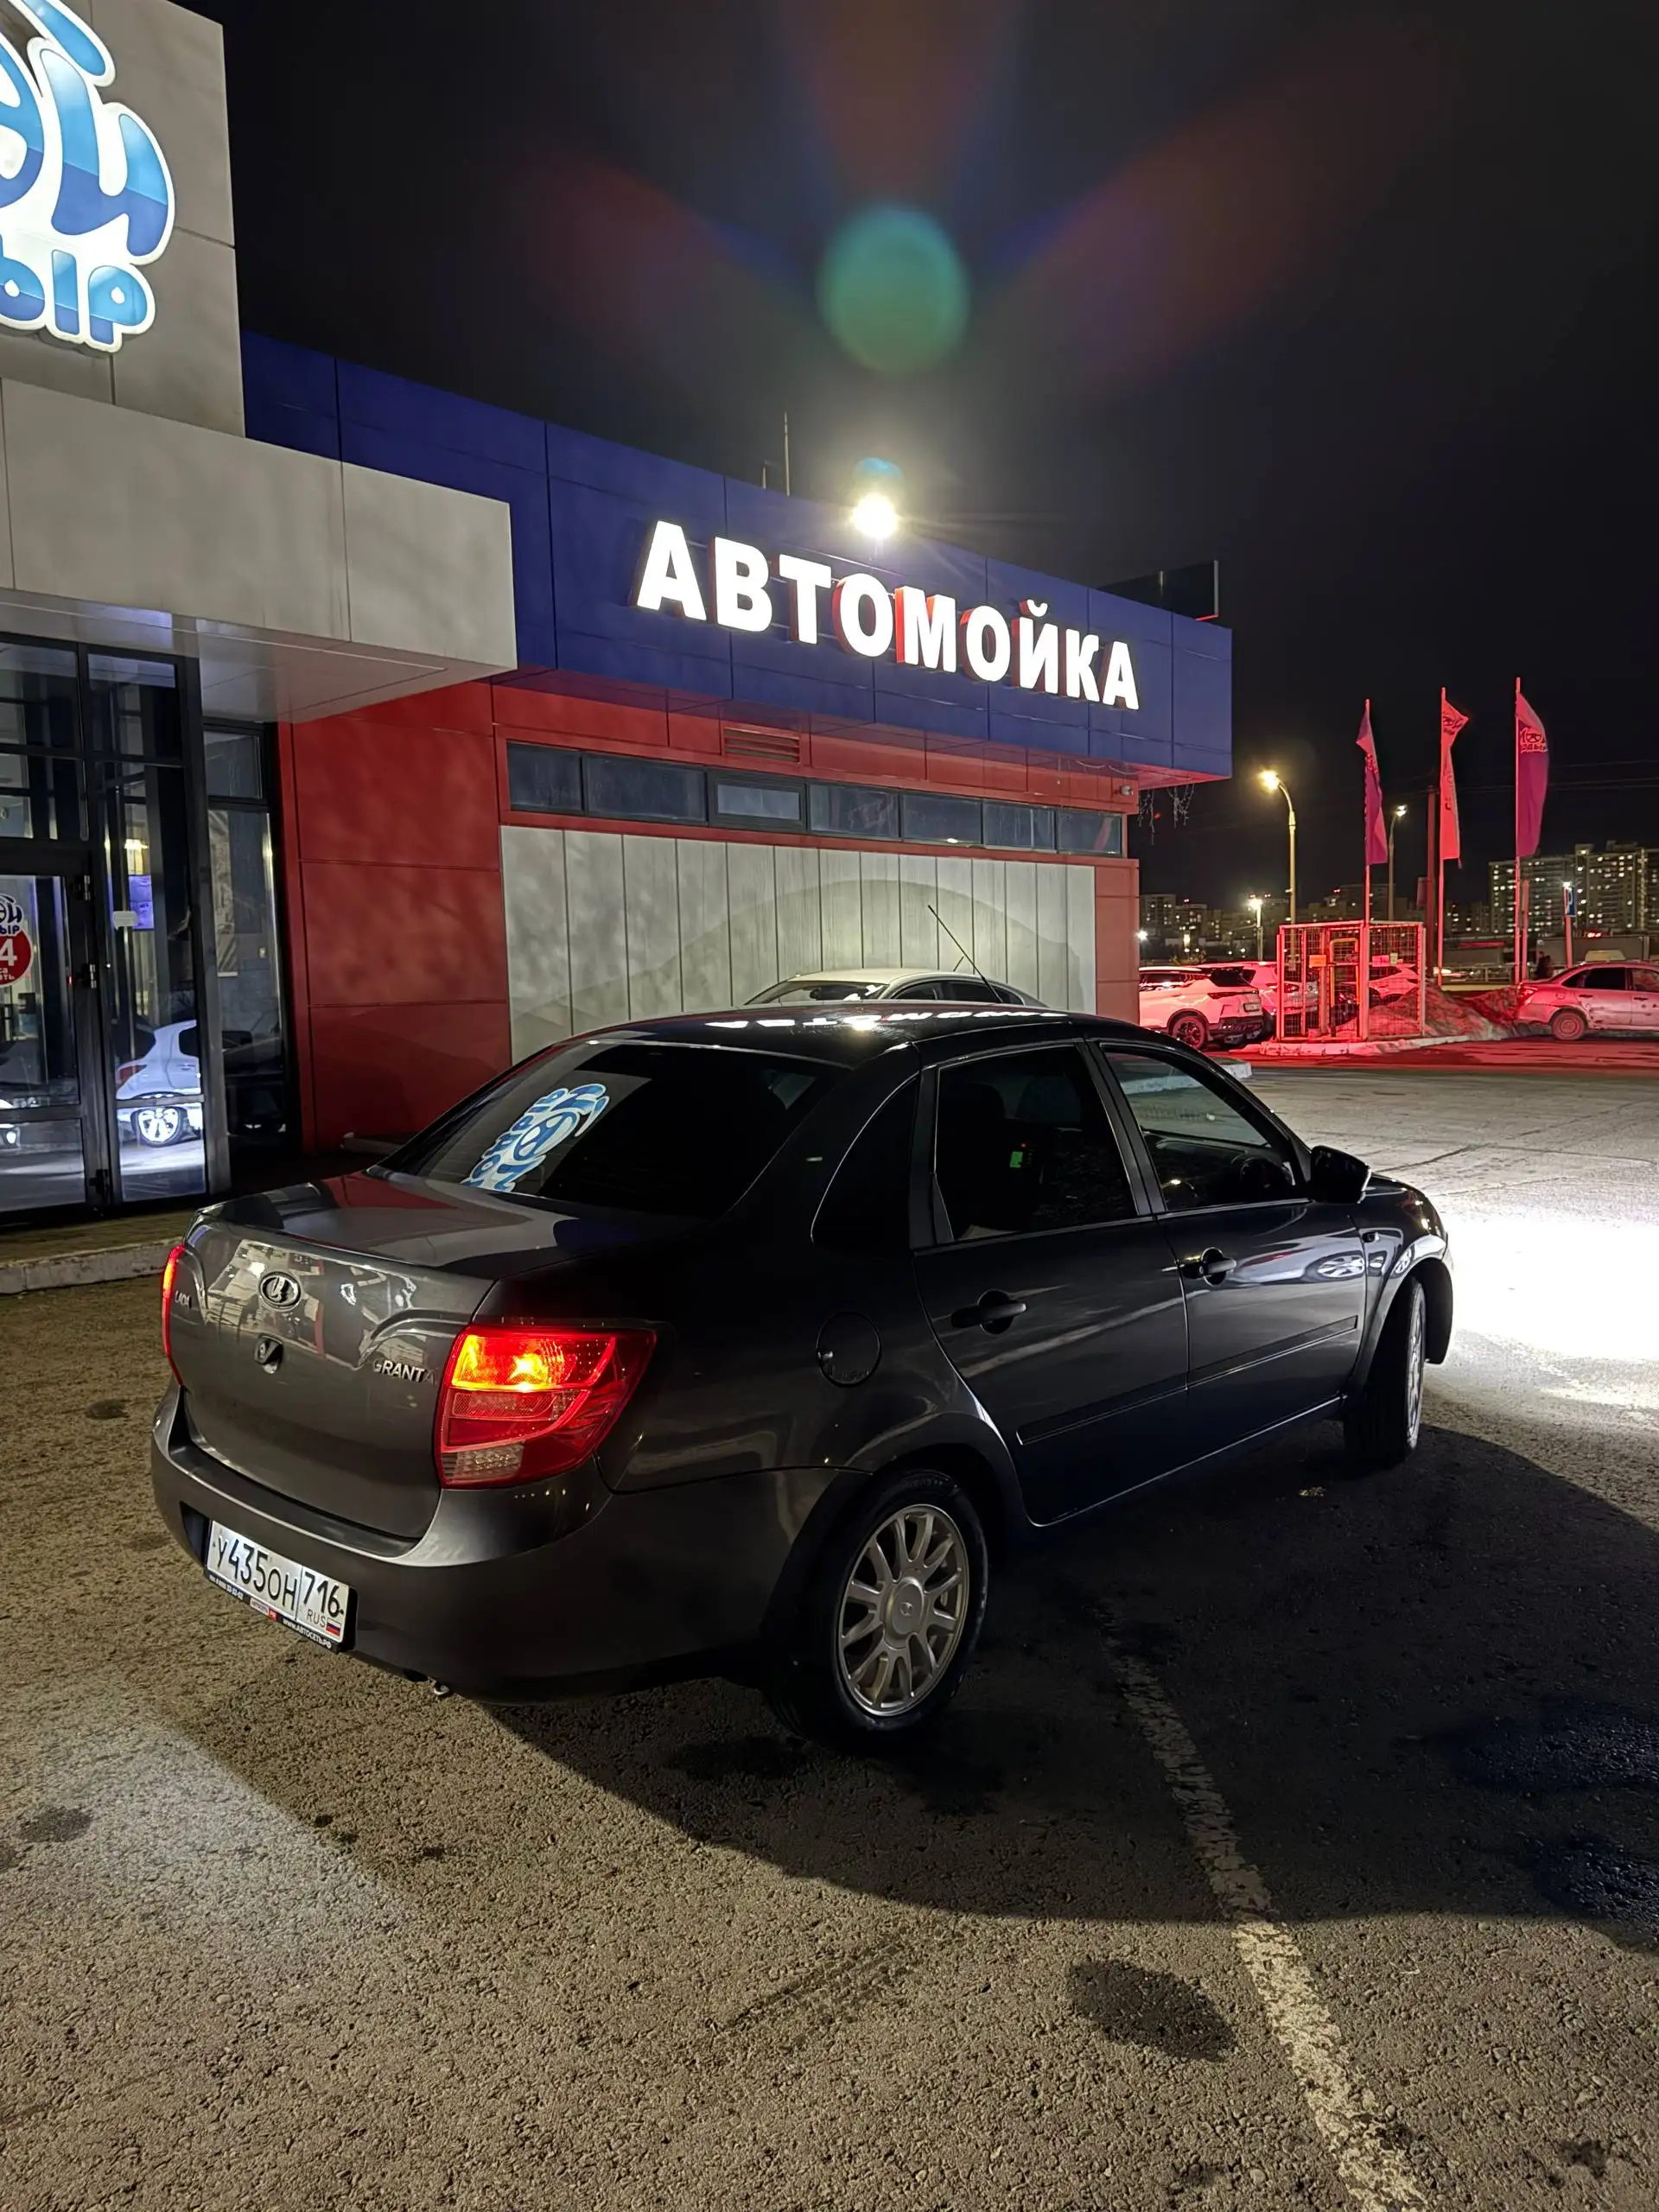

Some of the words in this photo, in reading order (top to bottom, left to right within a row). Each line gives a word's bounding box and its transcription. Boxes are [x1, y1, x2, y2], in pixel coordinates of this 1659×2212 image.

[636, 520, 1140, 710] АВТОМОЙКА
[372, 1357, 436, 1387] GRANTA
[303, 1571, 341, 1618] 716
[306, 1609, 326, 1628] RUS
